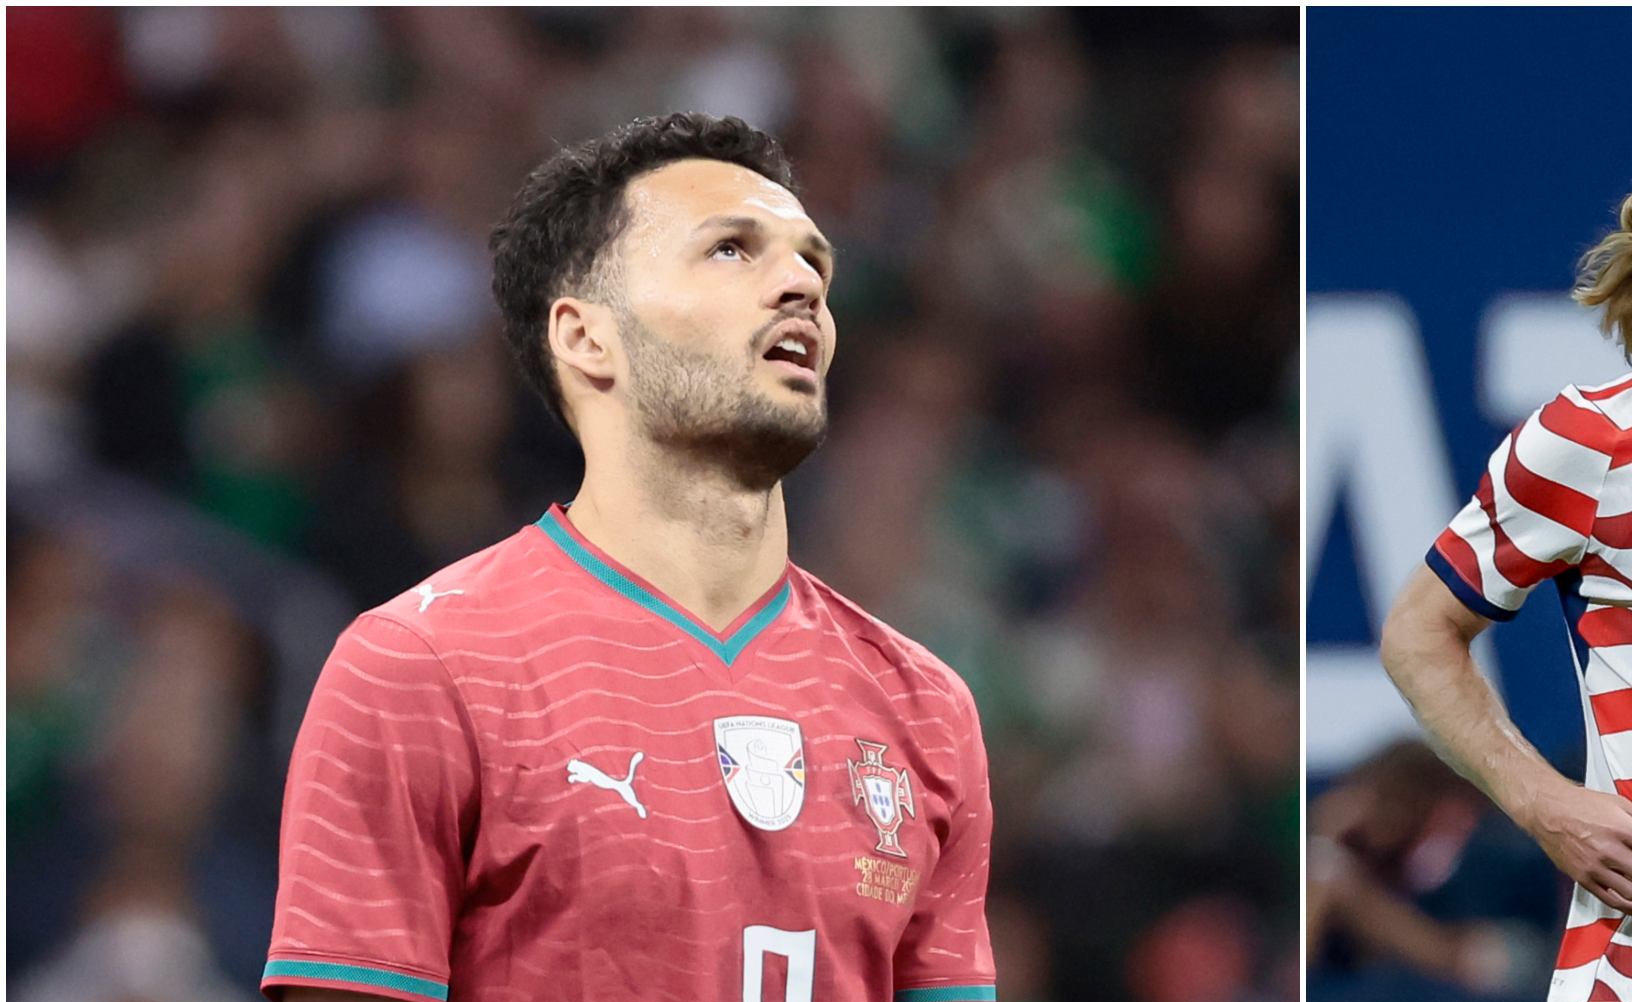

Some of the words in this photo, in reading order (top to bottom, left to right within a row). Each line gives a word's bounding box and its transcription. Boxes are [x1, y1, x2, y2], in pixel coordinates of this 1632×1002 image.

[718, 721, 735, 730] UEFA
[736, 720, 766, 729] NATIONS
[768, 721, 795, 733] LEAGUE
[885, 888, 895, 903] DO
